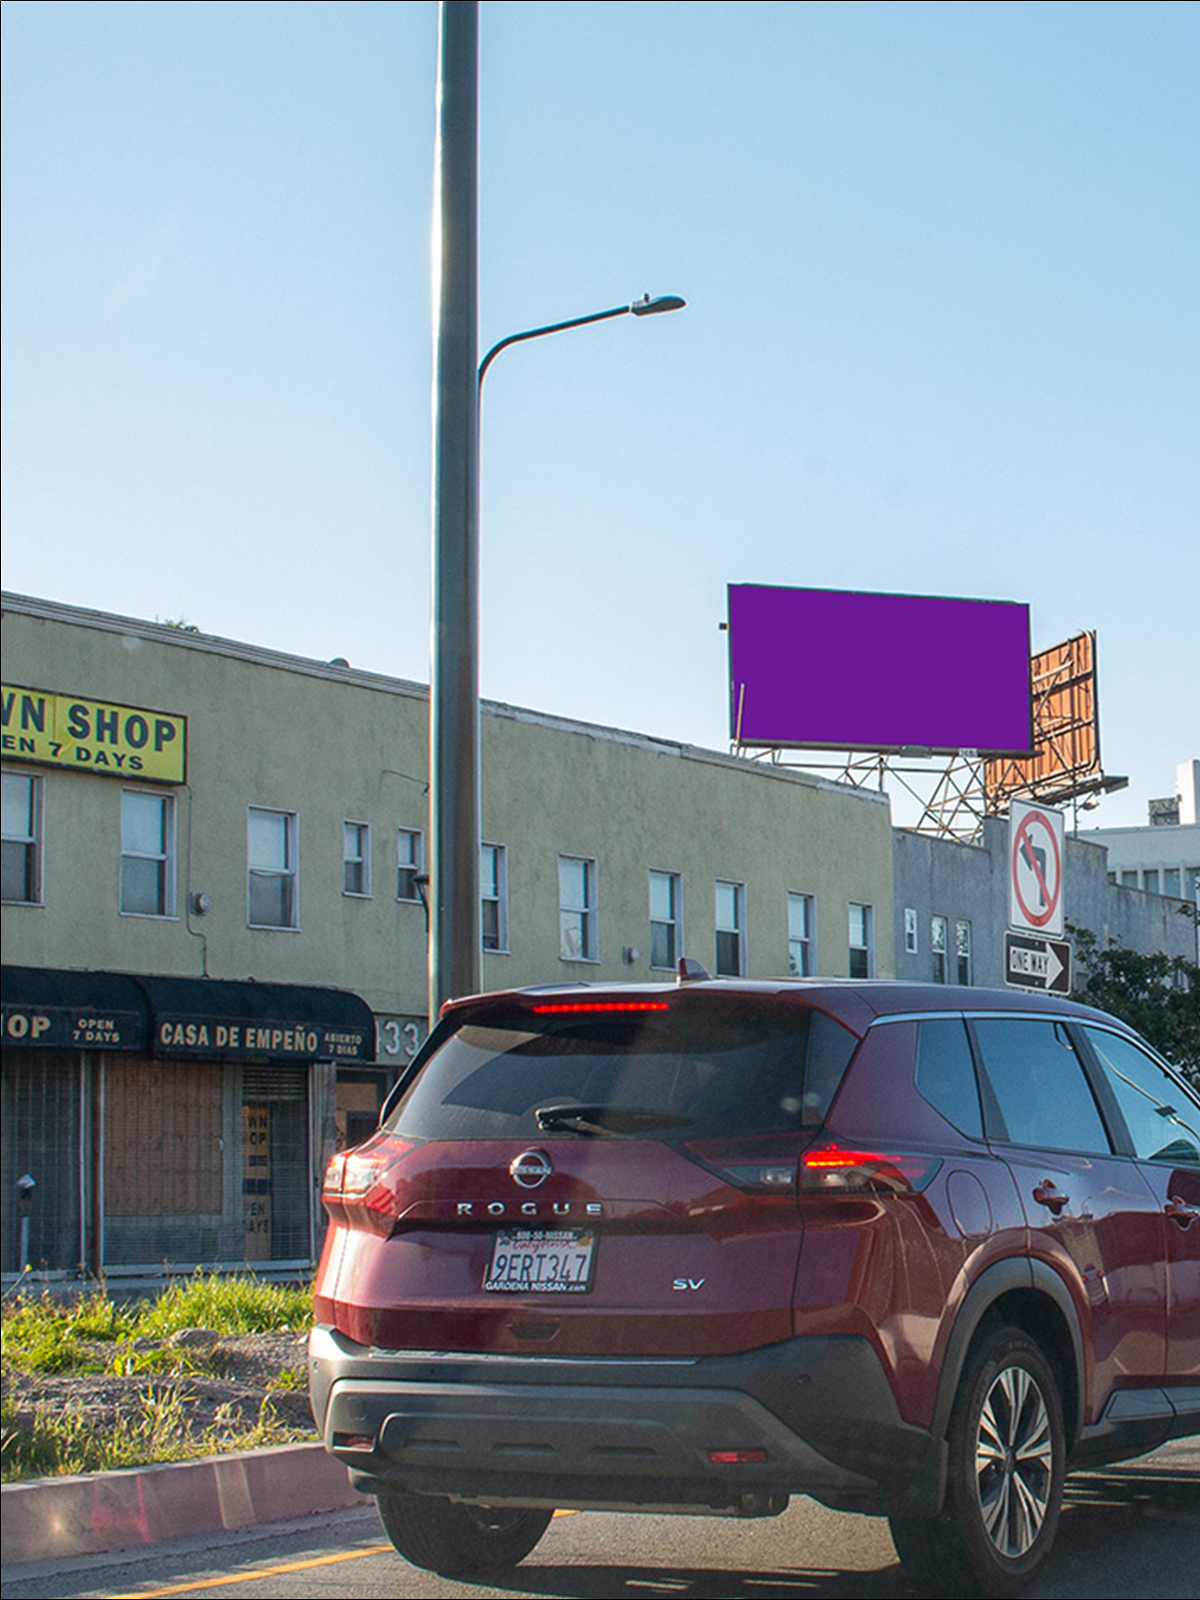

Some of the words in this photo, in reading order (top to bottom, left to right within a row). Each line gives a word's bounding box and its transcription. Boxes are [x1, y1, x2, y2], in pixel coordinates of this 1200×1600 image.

[67, 703, 177, 753] SHOP
[48, 741, 63, 758] 7
[76, 746, 144, 771] DAYS
[1012, 950, 1029, 972] ONE
[1030, 952, 1050, 976] WAY
[1, 1013, 51, 1039] OP
[77, 1018, 115, 1030] OPEN
[72, 1030, 82, 1041] 7
[85, 1031, 121, 1043] DAYS
[160, 1022, 210, 1047] CASA
[215, 1025, 239, 1048] DE
[245, 1025, 318, 1052] EMPEÑO
[324, 1032, 363, 1045] ABIERTO
[329, 1044, 335, 1054] 7
[510, 1165, 552, 1175] NISSAN
[456, 1202, 603, 1216] ROGUE
[492, 1253, 588, 1282] 9ERT347
[485, 1280, 530, 1292] GARDENA
[671, 1278, 706, 1291] SV
